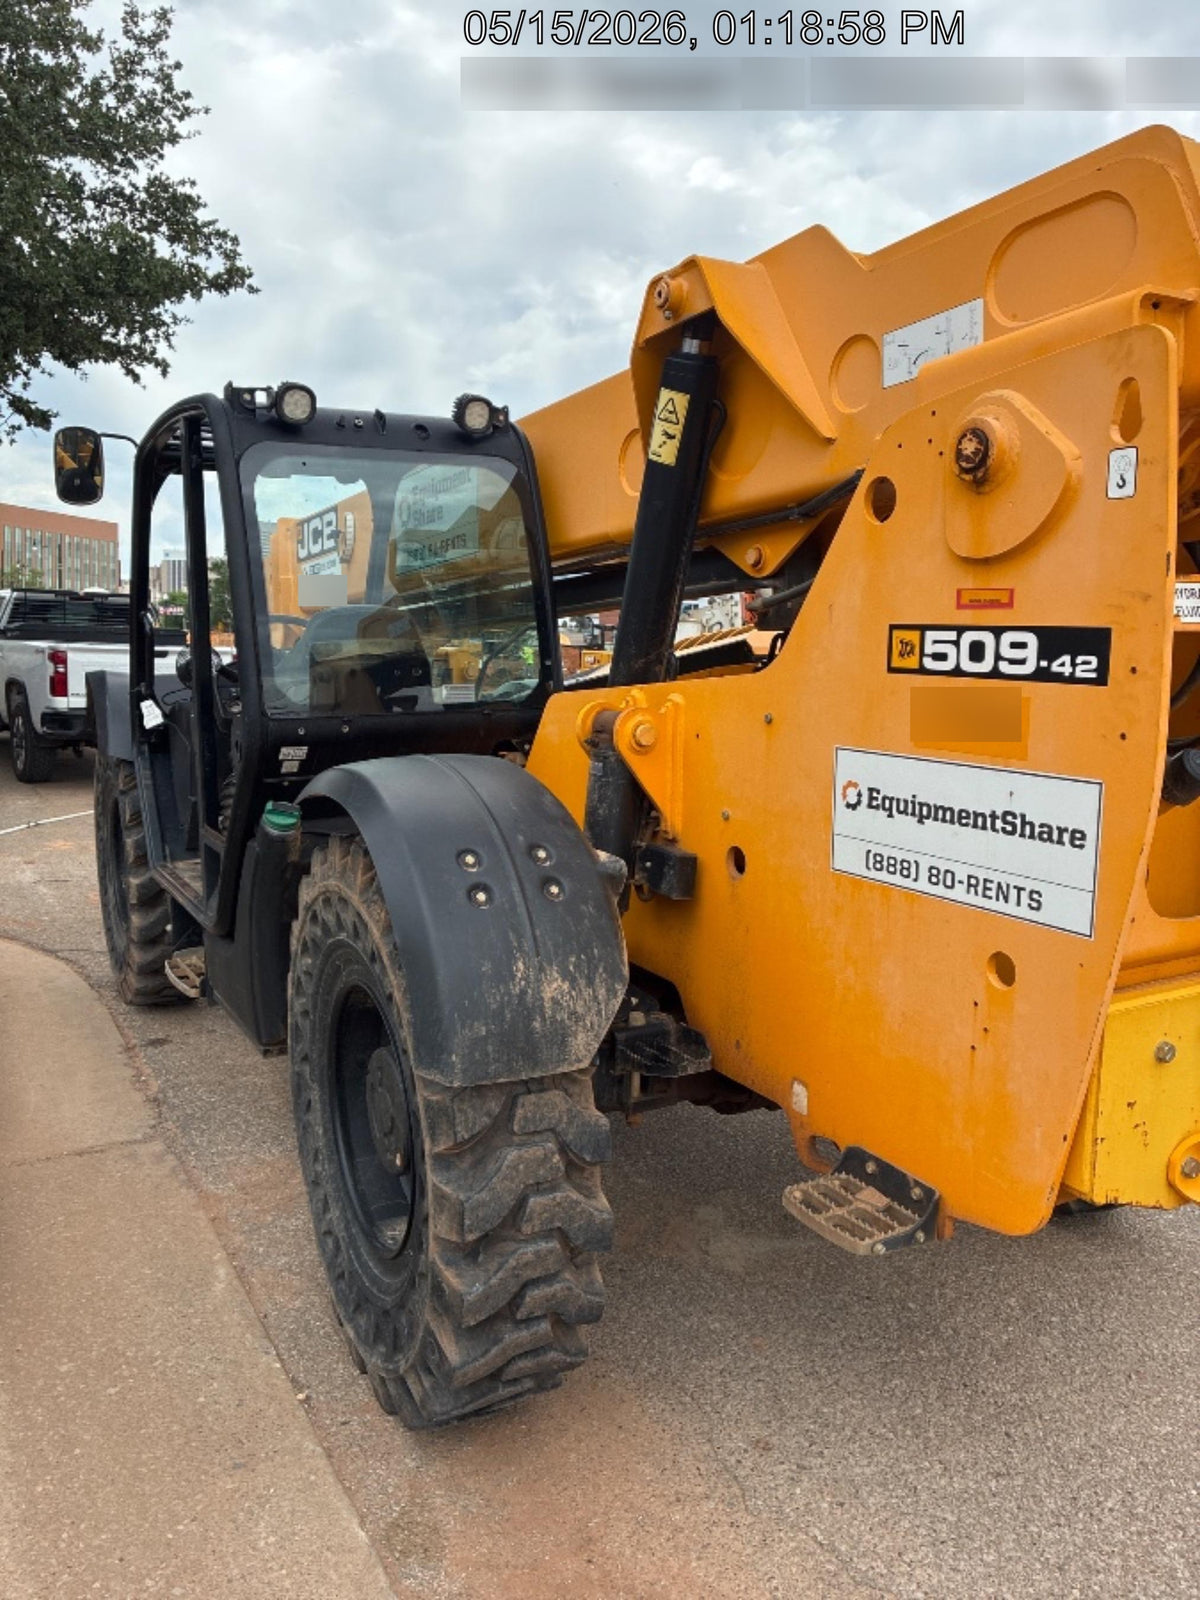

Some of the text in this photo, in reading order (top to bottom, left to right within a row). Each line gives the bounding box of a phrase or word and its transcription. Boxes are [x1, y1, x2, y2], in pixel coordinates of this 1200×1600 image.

[297, 511, 337, 559] JCB
[922, 630, 1098, 678] 509-42
[866, 787, 1088, 850] EquipmentShare
[865, 849, 1044, 913] (888) 80-RENTS
